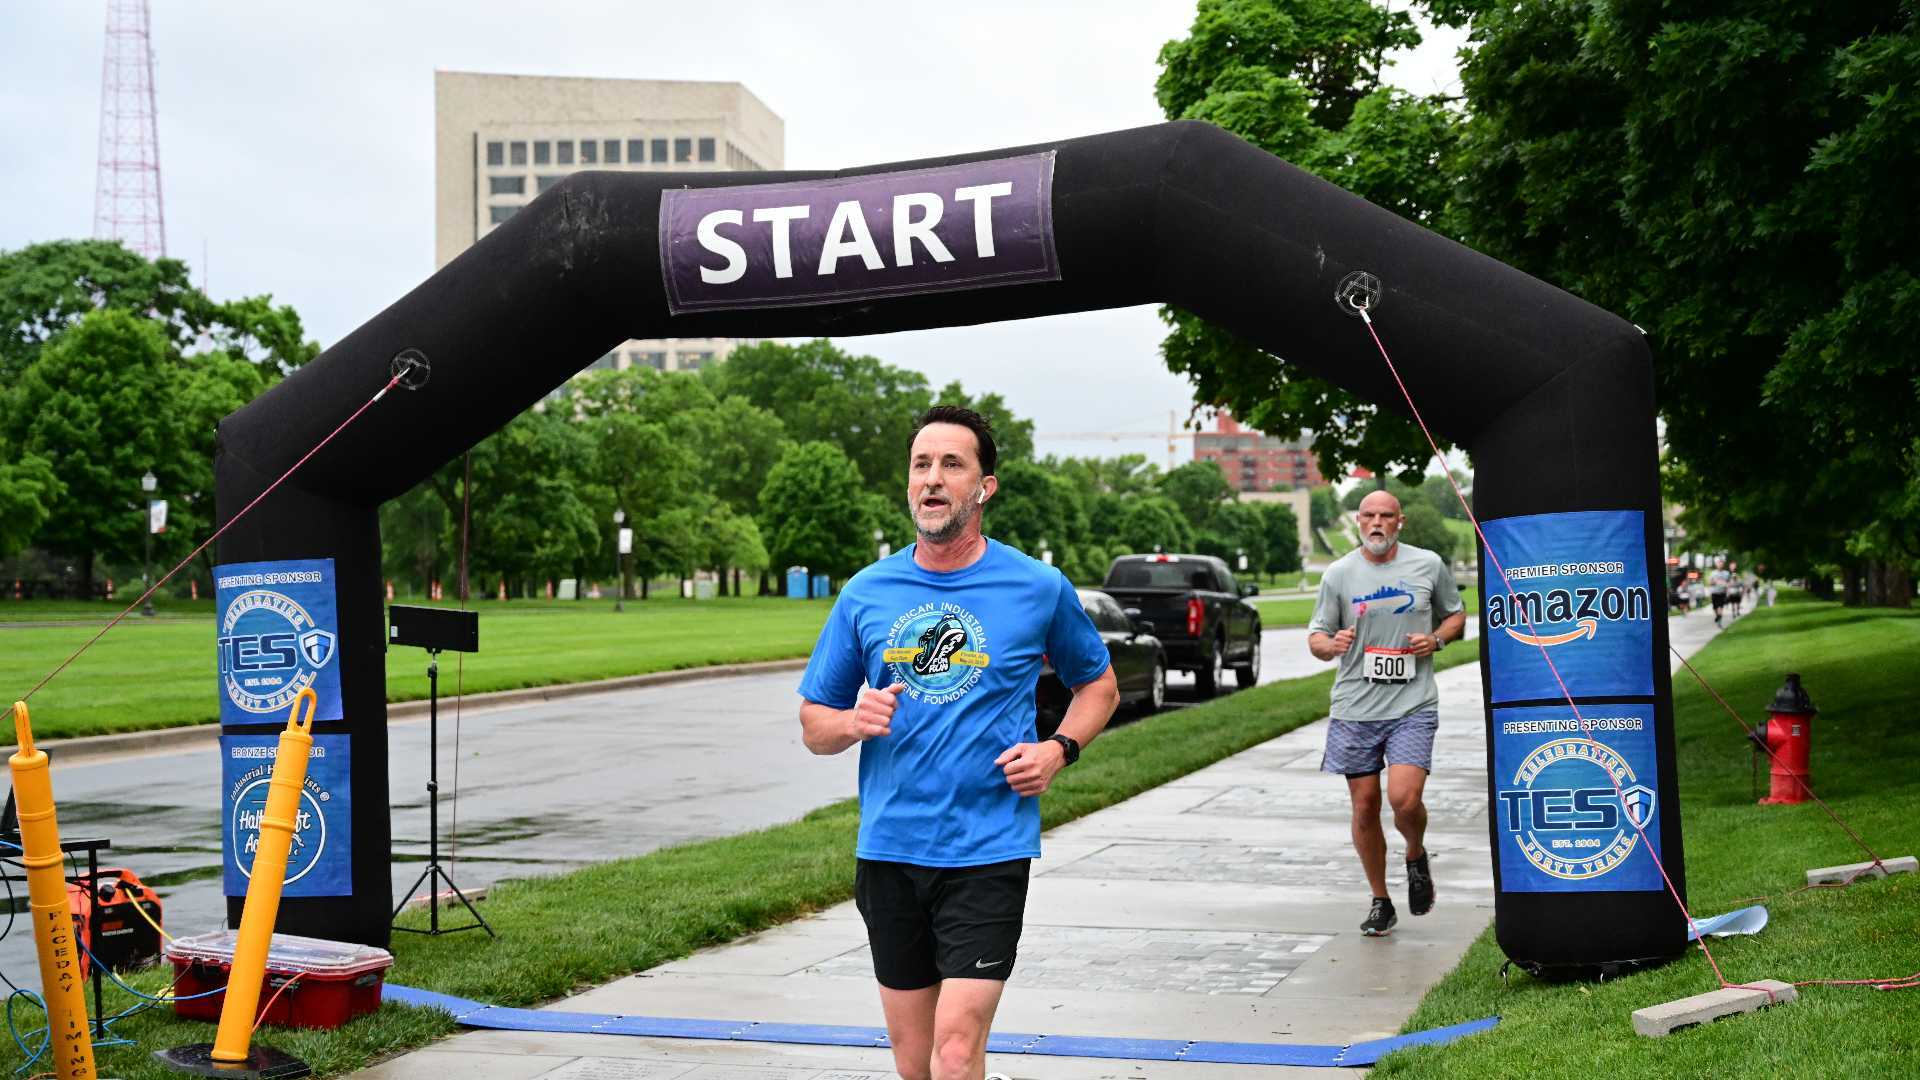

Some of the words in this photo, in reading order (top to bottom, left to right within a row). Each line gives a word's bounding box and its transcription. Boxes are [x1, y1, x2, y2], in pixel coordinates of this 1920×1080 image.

[696, 181, 1013, 285] START
[264, 571, 322, 584] SPONSOR
[1505, 565, 1557, 580] PREMIER
[1561, 562, 1624, 576] SPONSOR
[1488, 586, 1649, 628] amazon
[886, 602, 934, 647] AMERICAN
[941, 602, 988, 651] INDUSTRIAL
[218, 633, 297, 673] TES
[929, 664, 948, 674] RUN
[933, 657, 948, 665] FUN
[1375, 656, 1404, 677] 500
[923, 668, 983, 705] FOUNDATION
[1503, 719, 1578, 734] PRESENTING
[1581, 718, 1643, 732] SPONSOR
[231, 746, 266, 759] BRONZE
[1522, 744, 1626, 783] CELEBRATING
[230, 764, 263, 801] Industrial
[1499, 788, 1619, 832] TES
[1526, 840, 1575, 875] FORTY
[1584, 835, 1633, 875] YEARS
